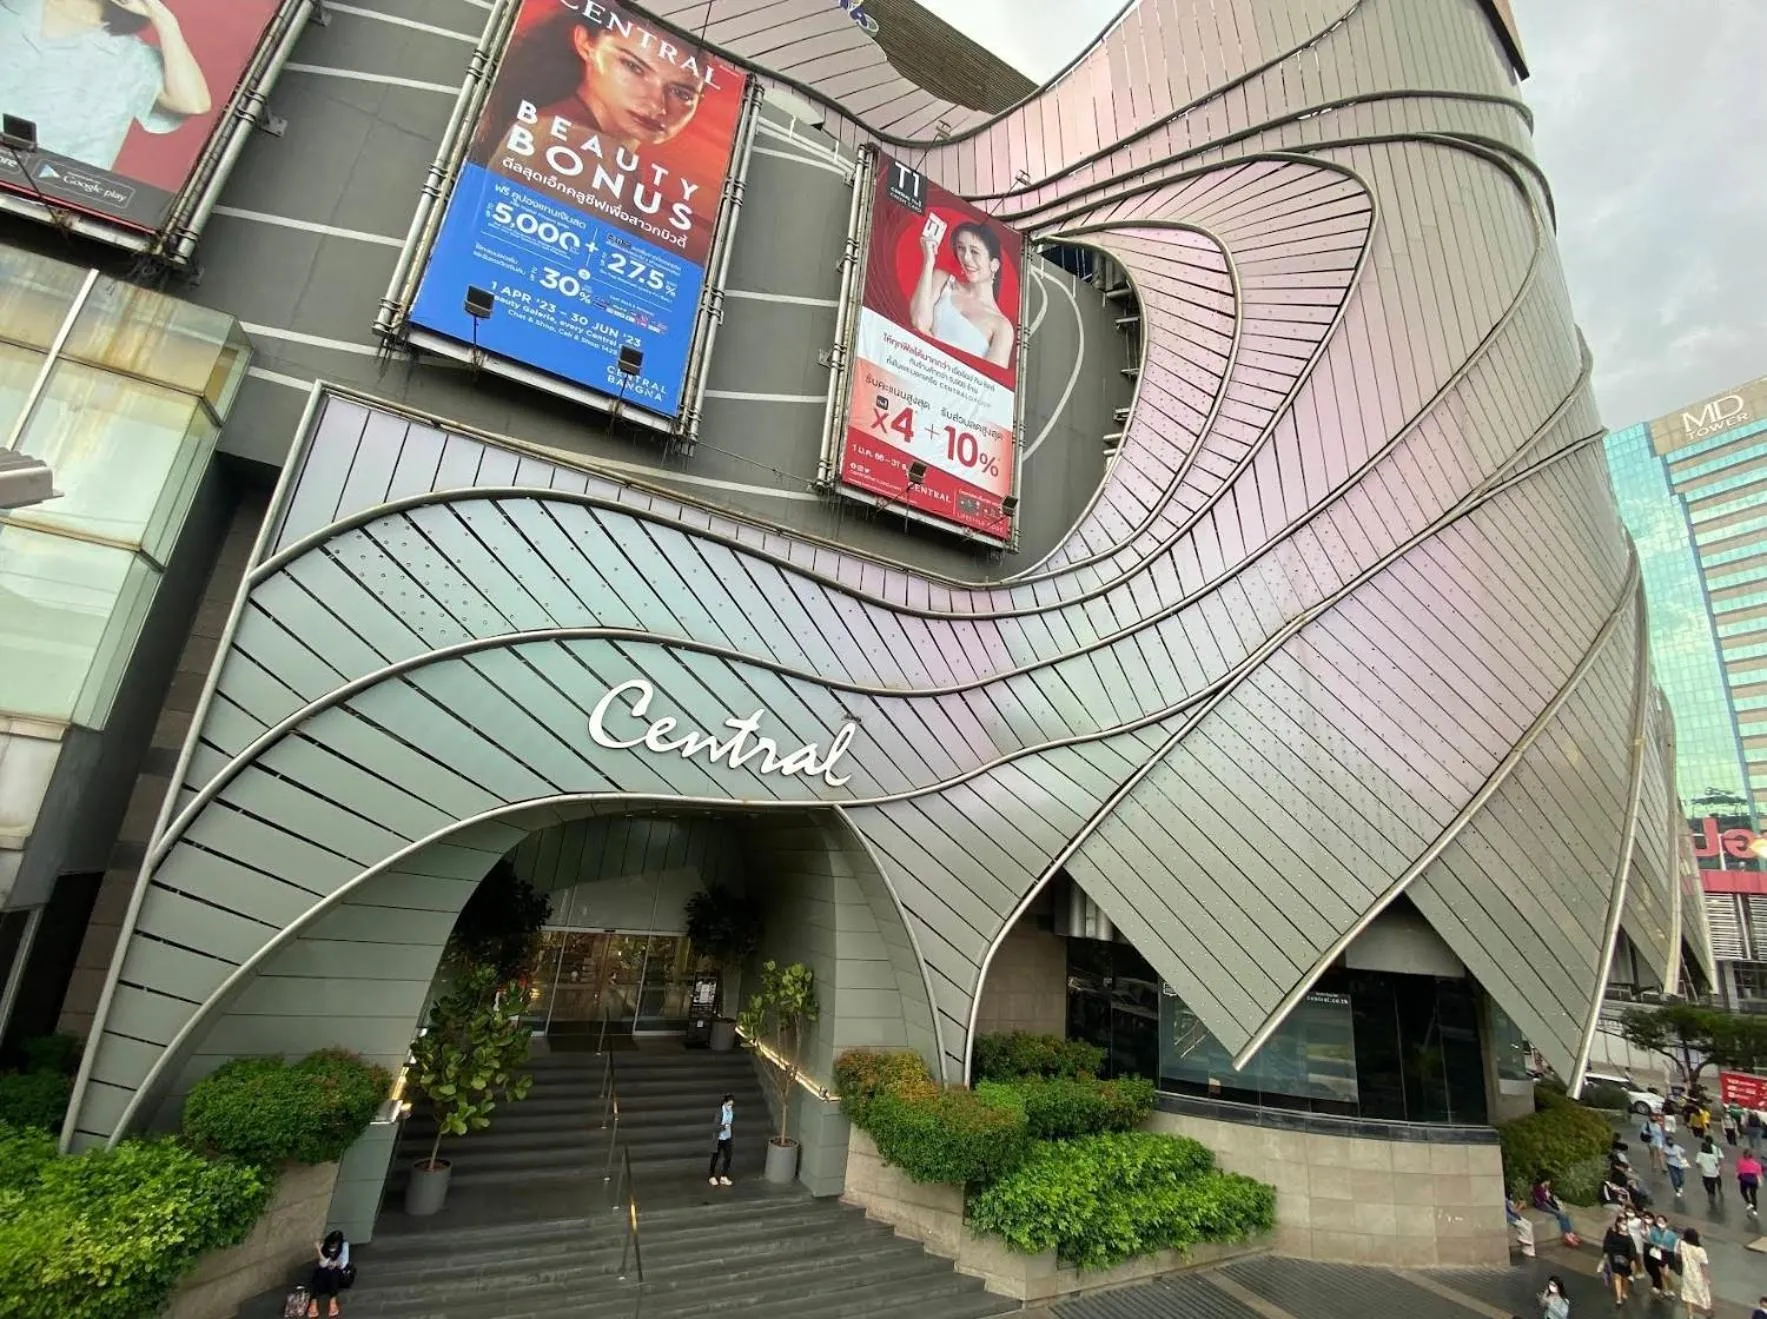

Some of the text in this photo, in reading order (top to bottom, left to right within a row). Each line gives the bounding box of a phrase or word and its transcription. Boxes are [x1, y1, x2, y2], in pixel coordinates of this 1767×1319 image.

[516, 100, 699, 202] BEAUTY
[63, 174, 127, 202] Google play
[506, 124, 693, 231] BONUS
[894, 161, 920, 198] T1
[500, 286, 532, 305] APR
[570, 312, 589, 326] 30
[591, 322, 620, 339] JUN
[1681, 394, 1745, 433] MD
[1686, 411, 1750, 440] TOWER
[588, 679, 856, 787] Central
